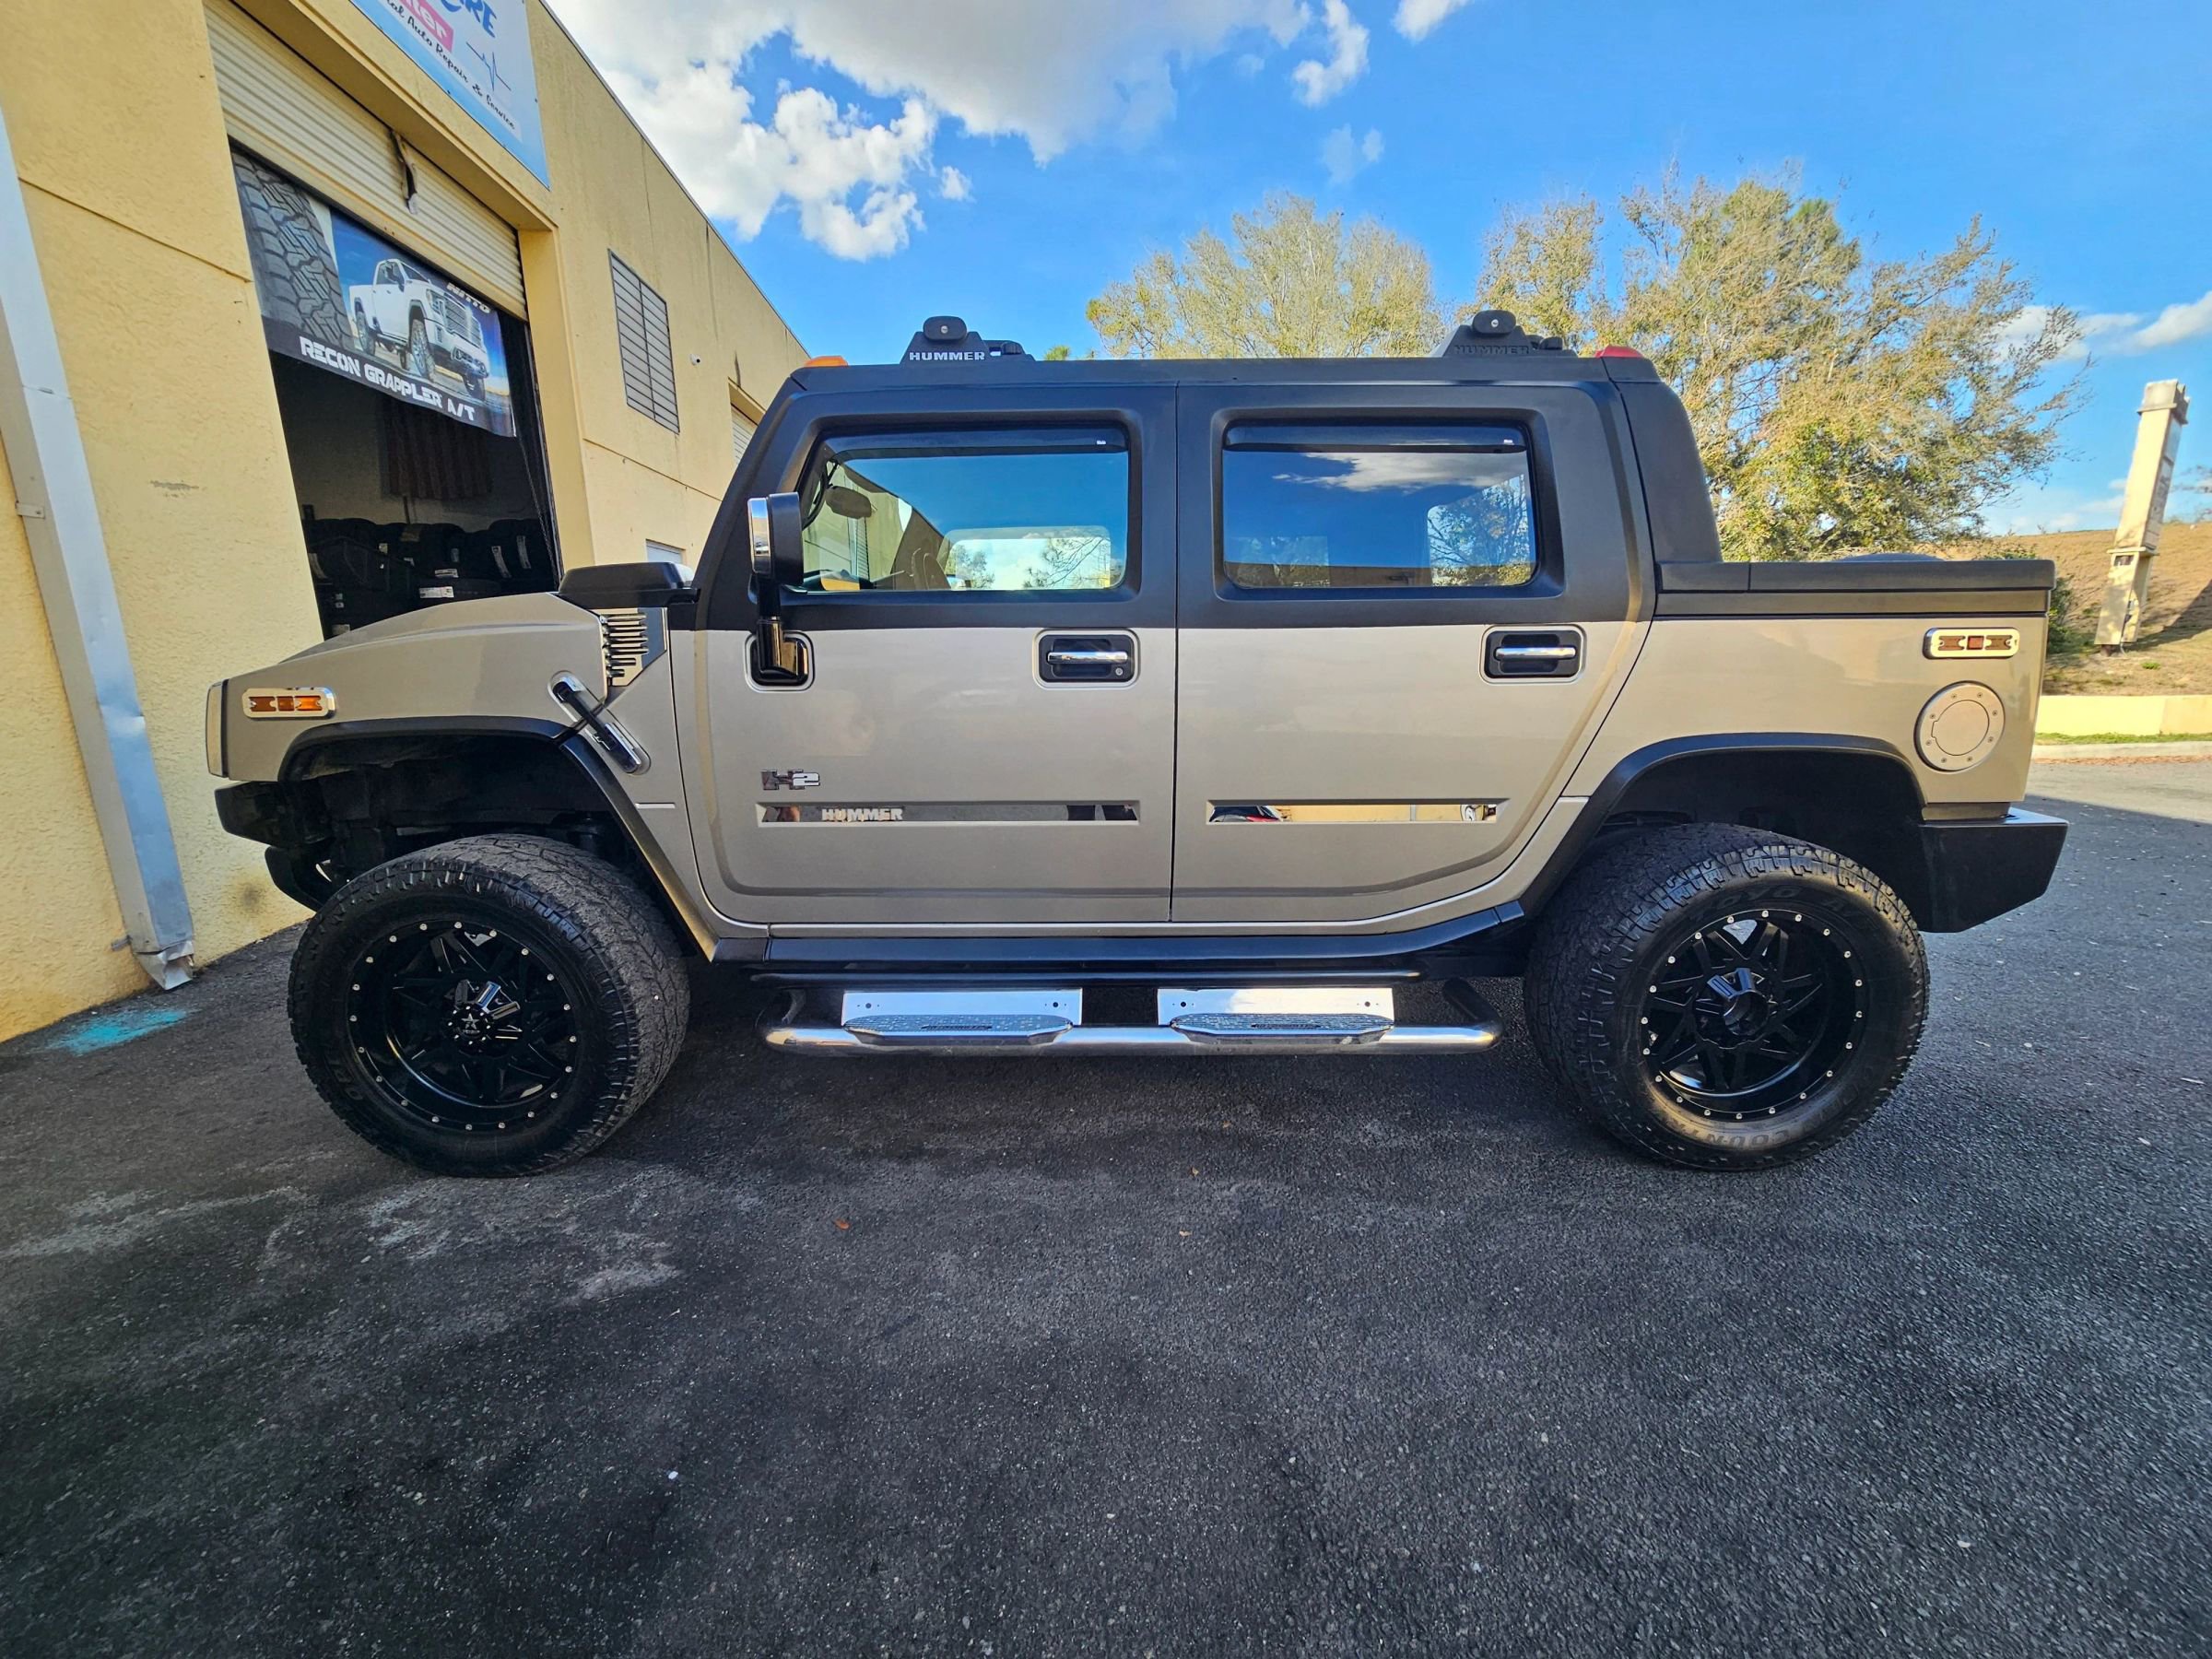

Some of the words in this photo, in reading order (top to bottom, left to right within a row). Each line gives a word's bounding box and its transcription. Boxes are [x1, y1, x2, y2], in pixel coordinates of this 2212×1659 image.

[407, 16, 432, 46] Auto
[436, 42, 468, 83] Repair
[472, 83, 483, 97] &
[486, 94, 515, 129] Service
[446, 282, 492, 314] NITTO
[909, 351, 986, 360] HUMMER
[300, 335, 362, 377] RECON
[364, 363, 443, 408] GRAPPLER
[447, 397, 476, 421] A/T
[821, 807, 904, 822] HUMMER
